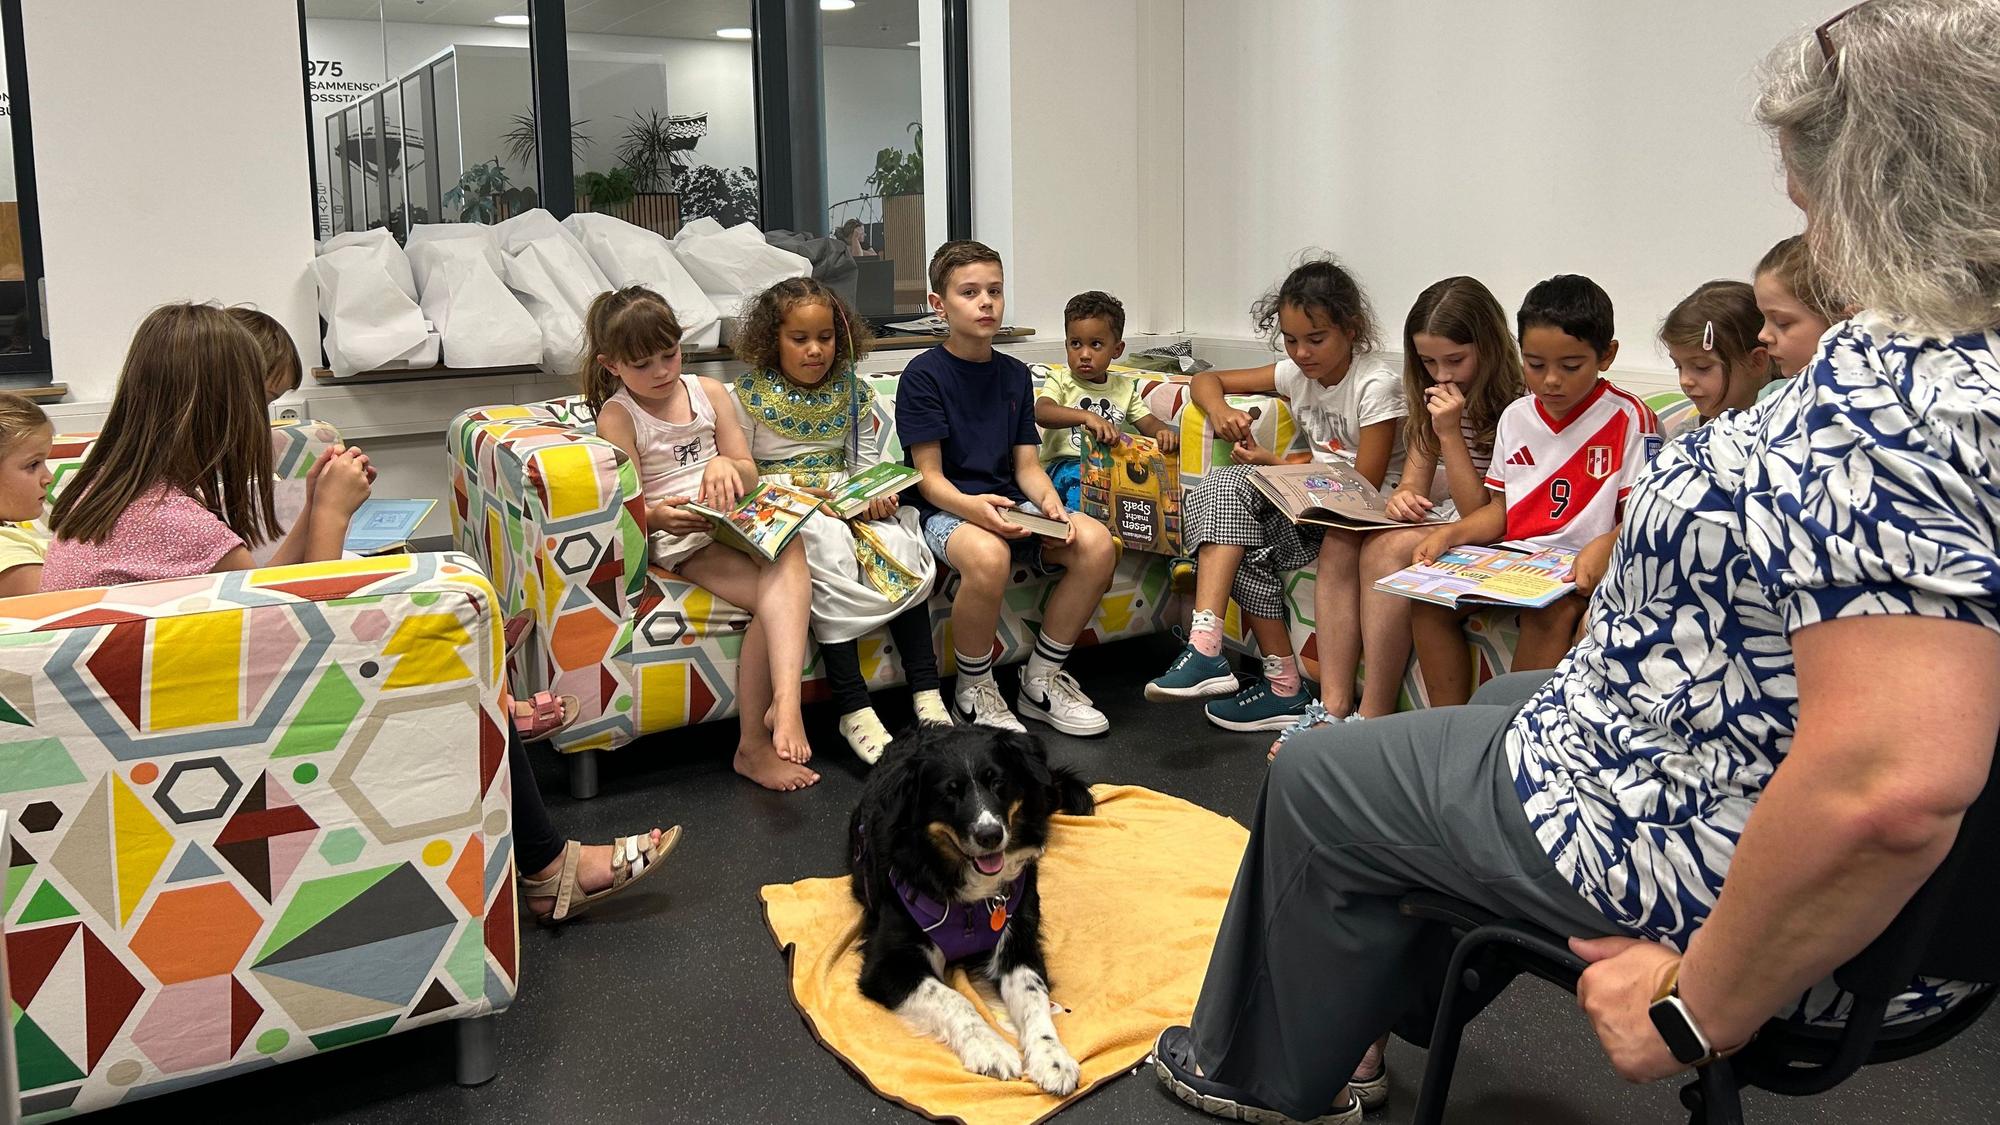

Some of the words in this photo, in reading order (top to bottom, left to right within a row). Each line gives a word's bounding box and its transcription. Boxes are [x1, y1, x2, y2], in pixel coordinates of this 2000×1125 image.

[310, 81, 380, 92] SAMMENSC
[311, 93, 363, 103] OSSSTA
[1550, 478, 1571, 520] 9
[1122, 500, 1151, 516] Spaß
[1125, 512, 1149, 522] macht
[1121, 520, 1153, 536] Lesen
